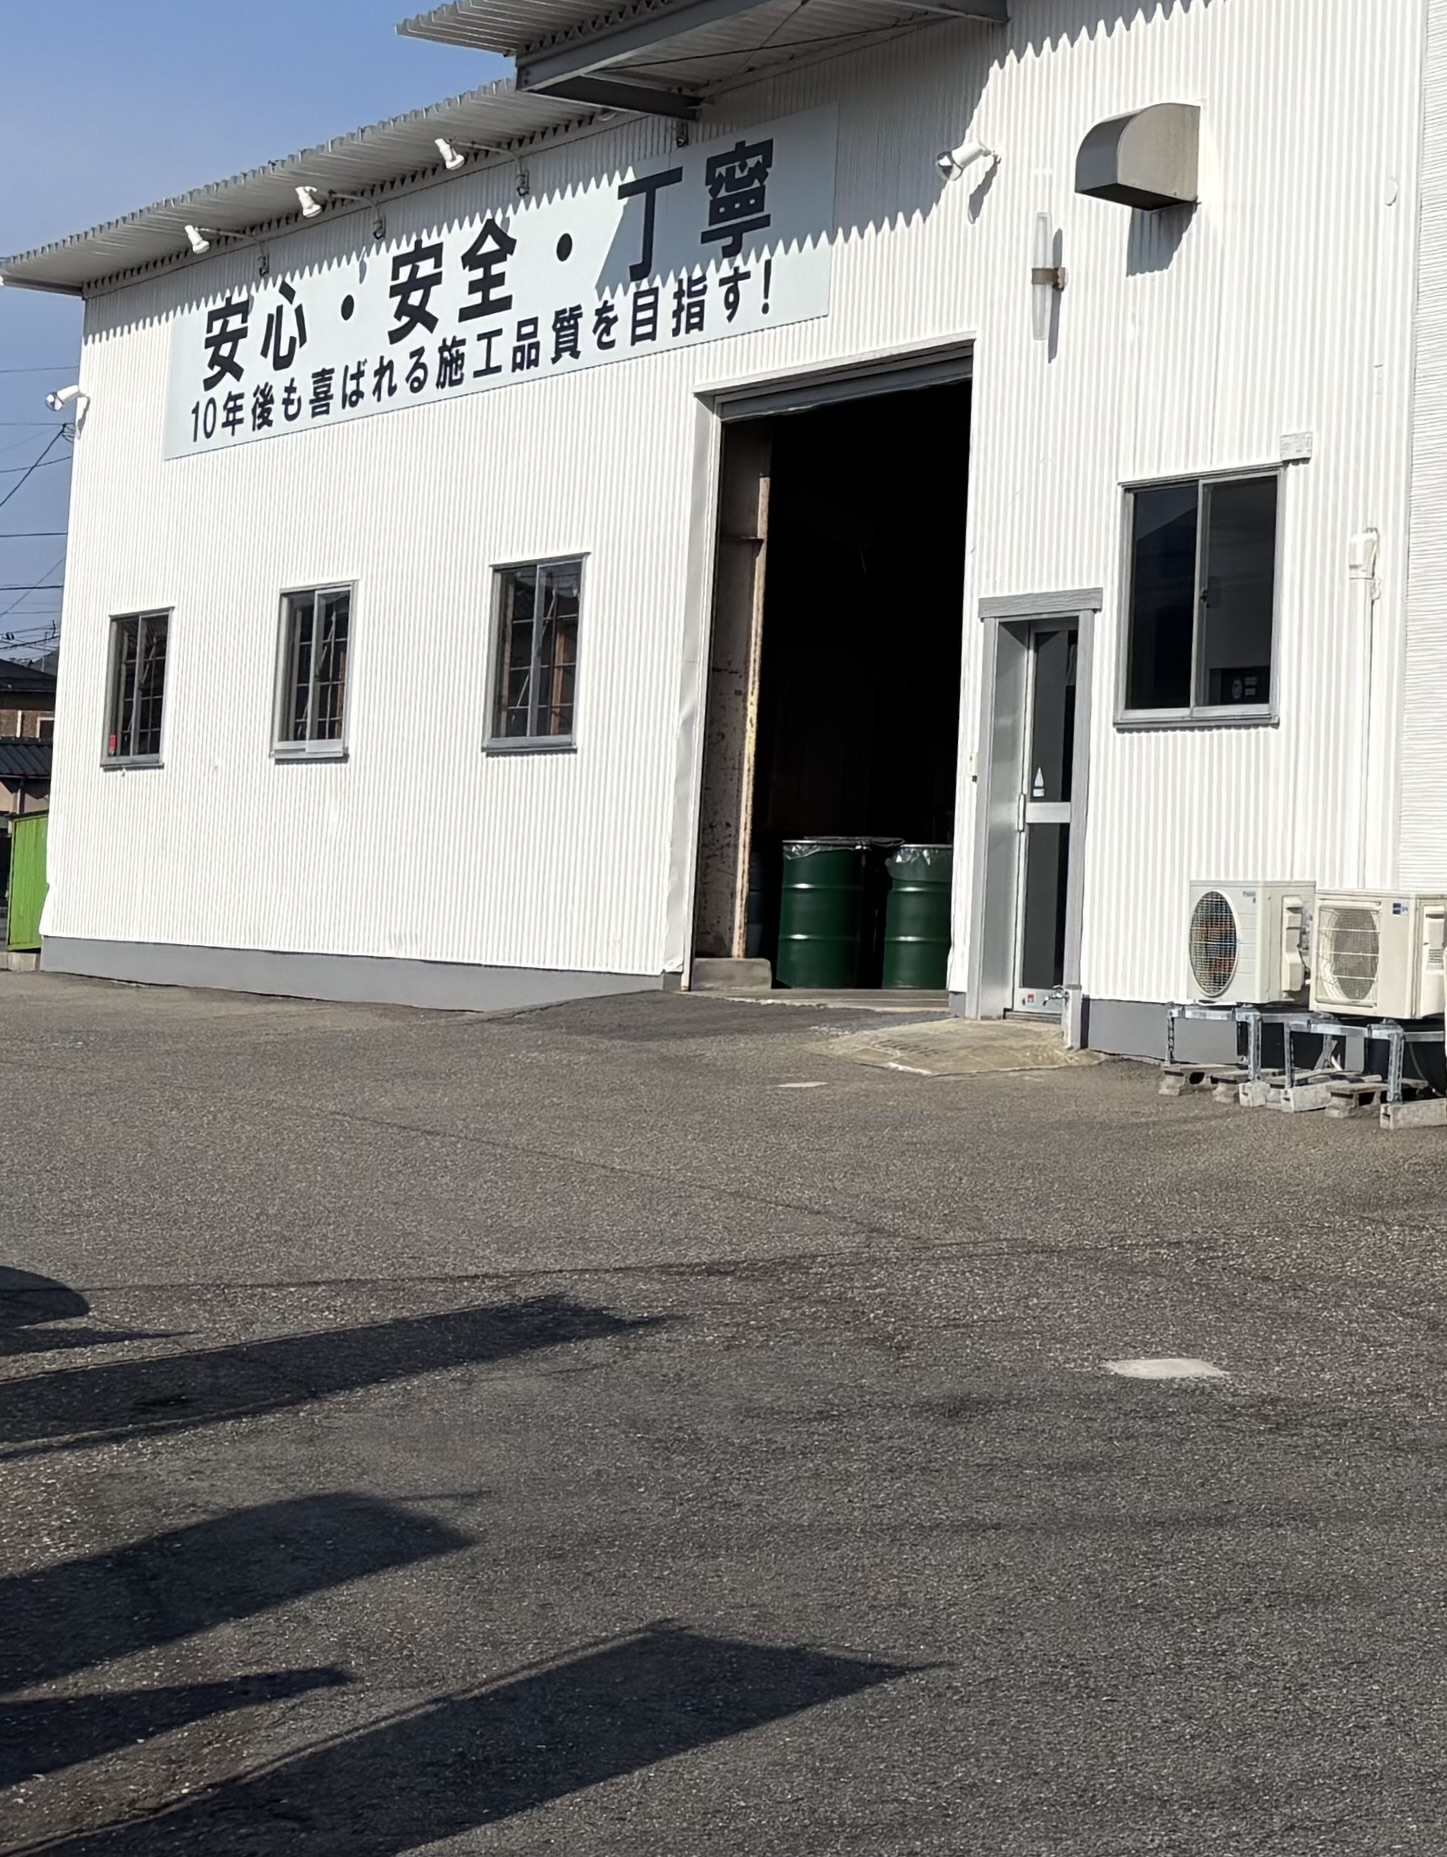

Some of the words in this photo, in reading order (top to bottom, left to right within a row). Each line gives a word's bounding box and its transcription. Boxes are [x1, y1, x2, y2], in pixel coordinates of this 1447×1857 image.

[203, 138, 775, 391] 安心・安全・丁寧
